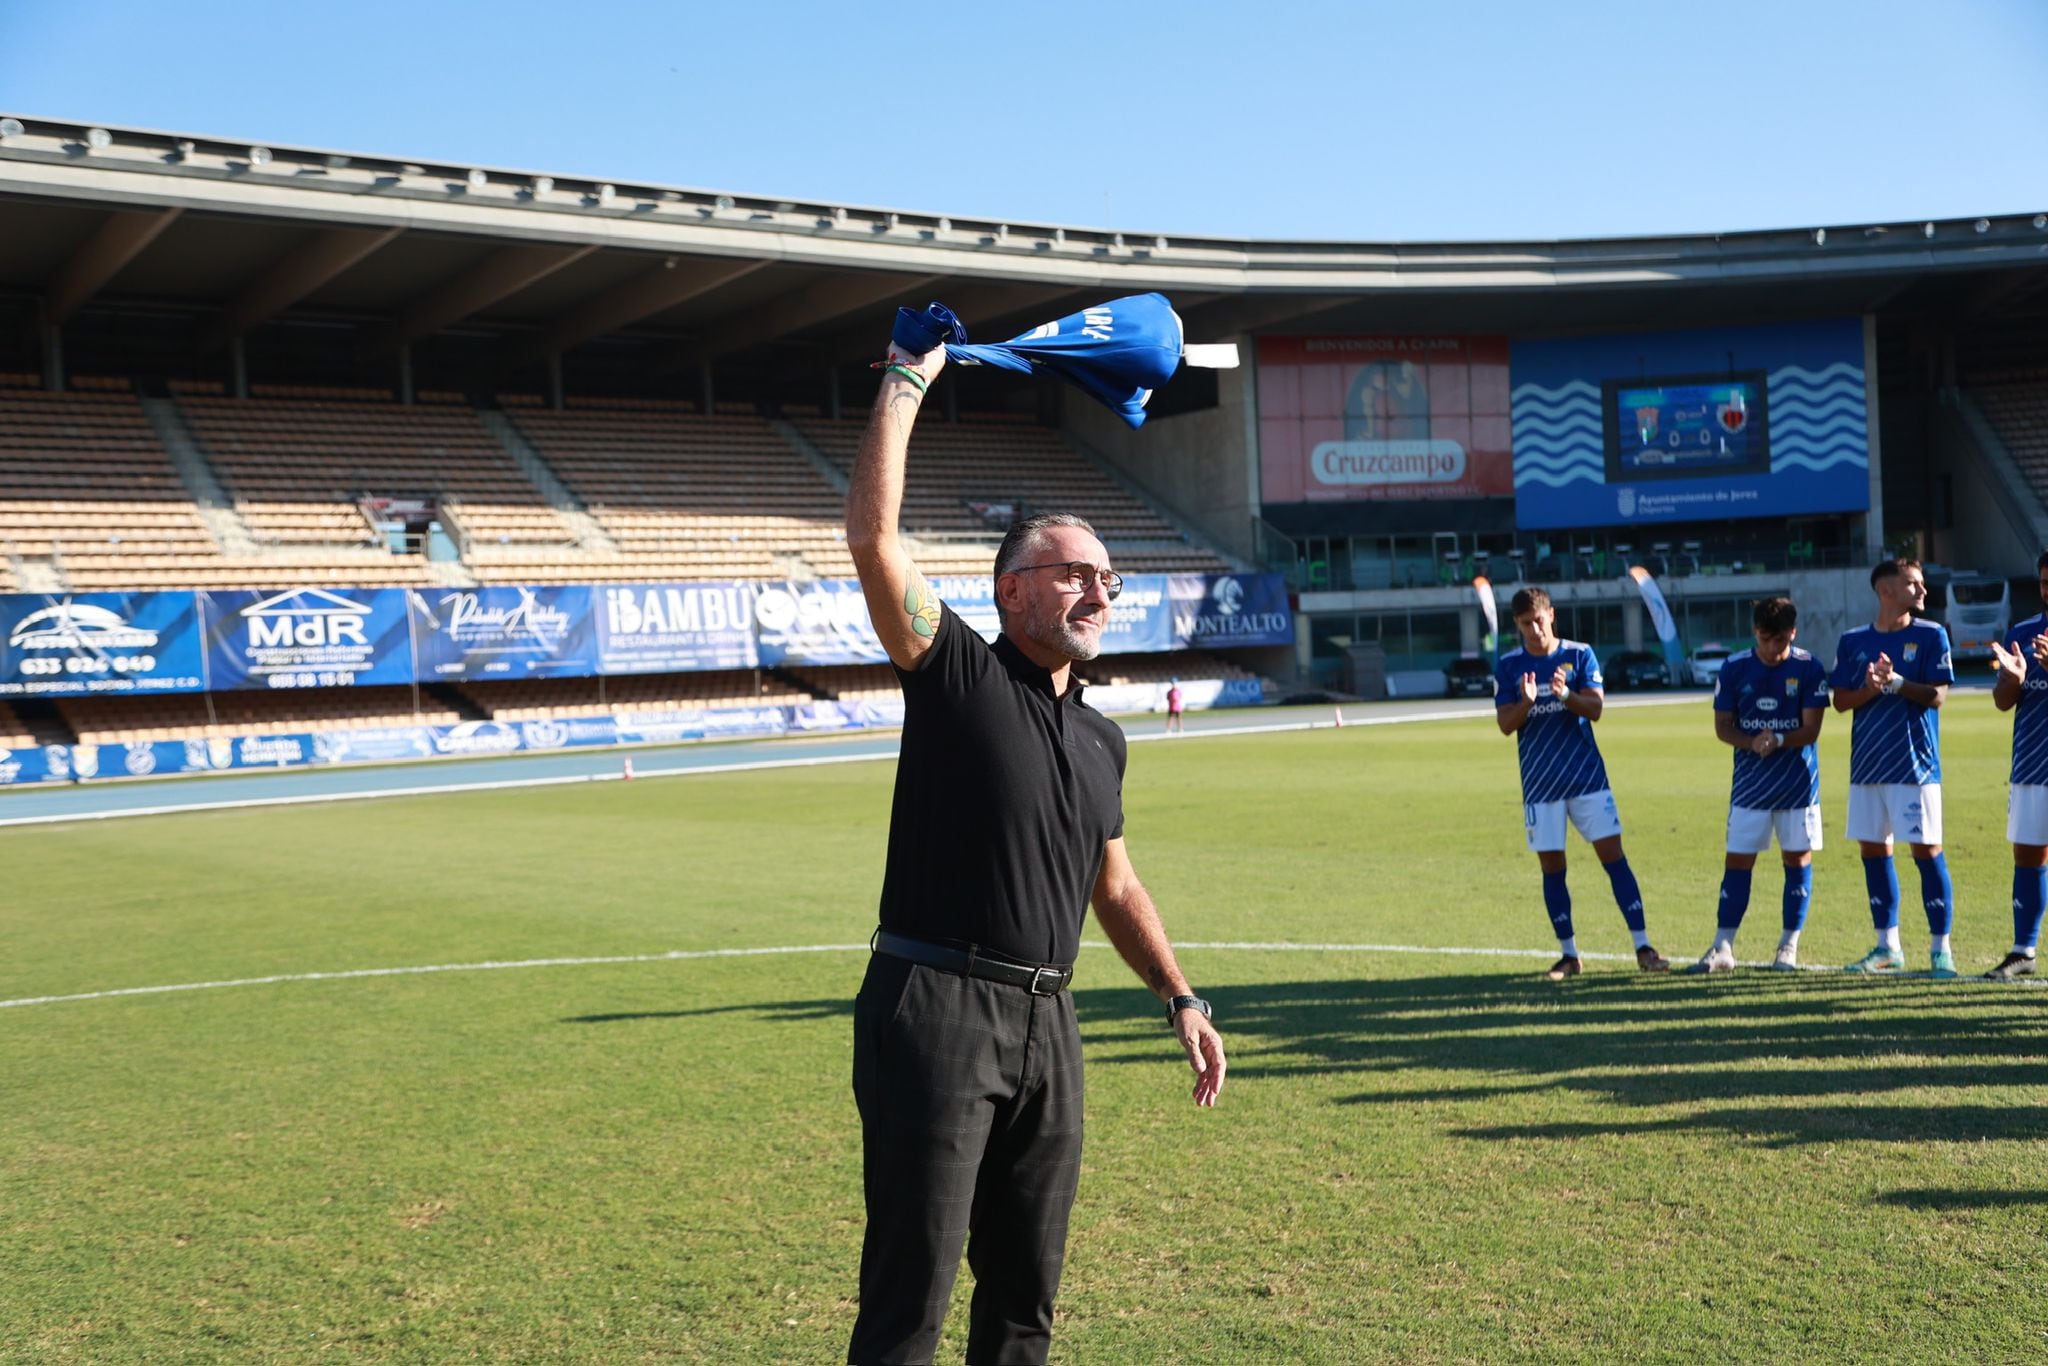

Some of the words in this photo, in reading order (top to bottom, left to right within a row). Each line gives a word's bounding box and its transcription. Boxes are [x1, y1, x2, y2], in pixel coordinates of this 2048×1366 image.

[1305, 338, 1394, 351] BIENVENIDOS
[1398, 339, 1408, 350] A
[1324, 449, 1455, 477] Cruzcampo
[1638, 492, 1713, 506] Ayuntamiento
[1715, 490, 1728, 501] de
[1730, 489, 1757, 502] Jerez
[247, 614, 368, 646] MdR
[1175, 613, 1286, 637] MONTEALTO
